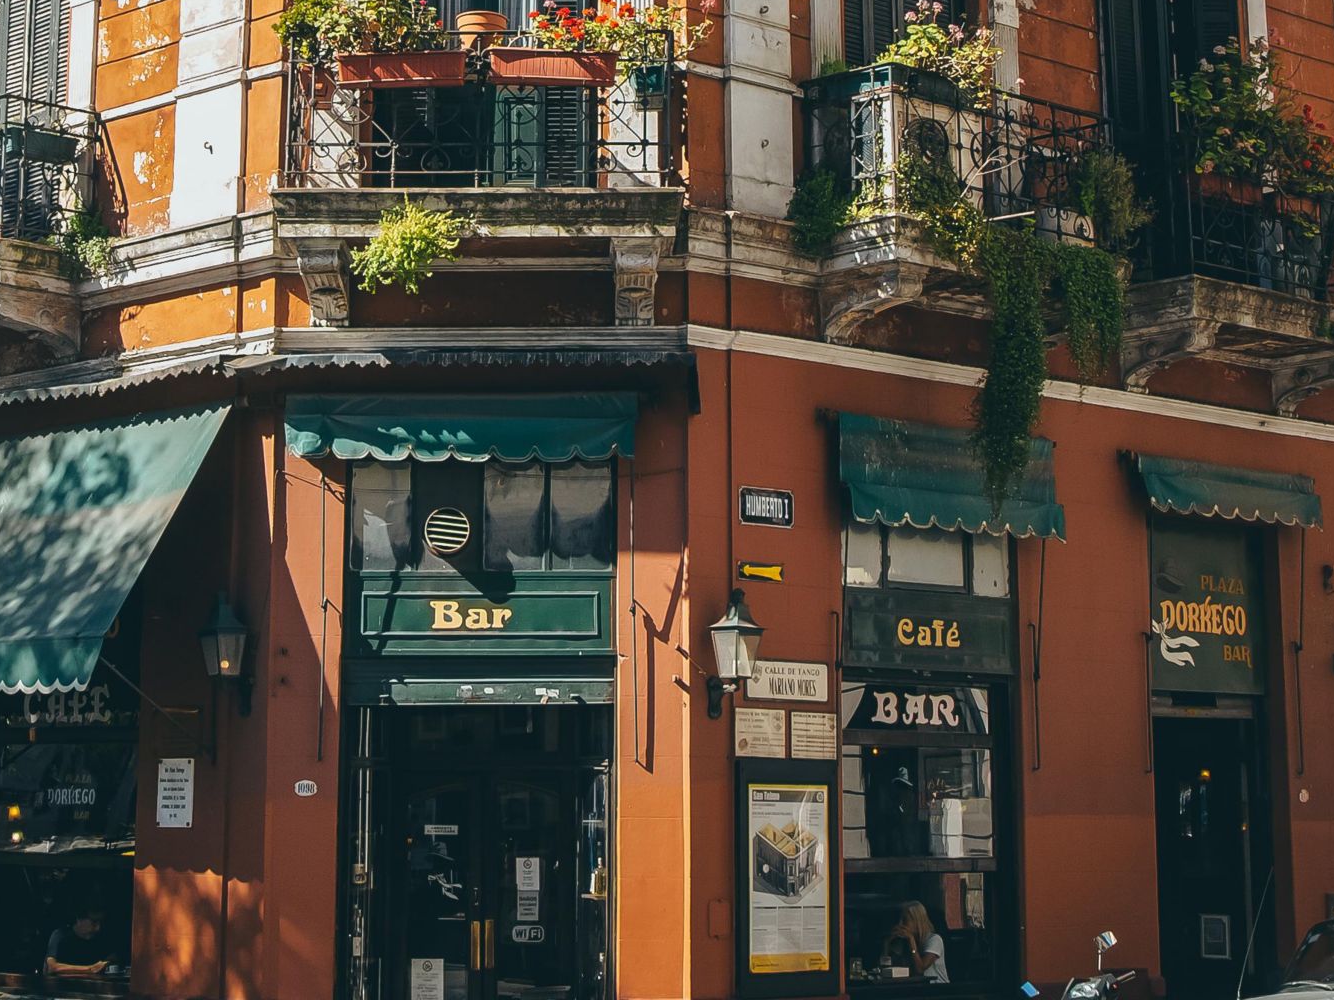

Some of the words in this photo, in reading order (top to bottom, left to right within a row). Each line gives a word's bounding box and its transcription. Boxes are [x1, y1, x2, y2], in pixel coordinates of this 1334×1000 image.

[745, 495, 783, 519] HUMBERTO
[784, 498, 789, 519] I
[1200, 575, 1245, 595] PLAZA
[429, 600, 513, 631] Bar
[1159, 595, 1247, 636] DORREGO
[897, 618, 961, 648] Café
[1223, 645, 1253, 669] BAR
[764, 666, 787, 675] CALLE
[798, 668, 820, 677] TANGO
[768, 677, 796, 696] MARIANO
[797, 679, 817, 696] MORES
[871, 691, 960, 727] BAR
[47, 785, 96, 806] DORREGO
[297, 782, 315, 794] 1098
